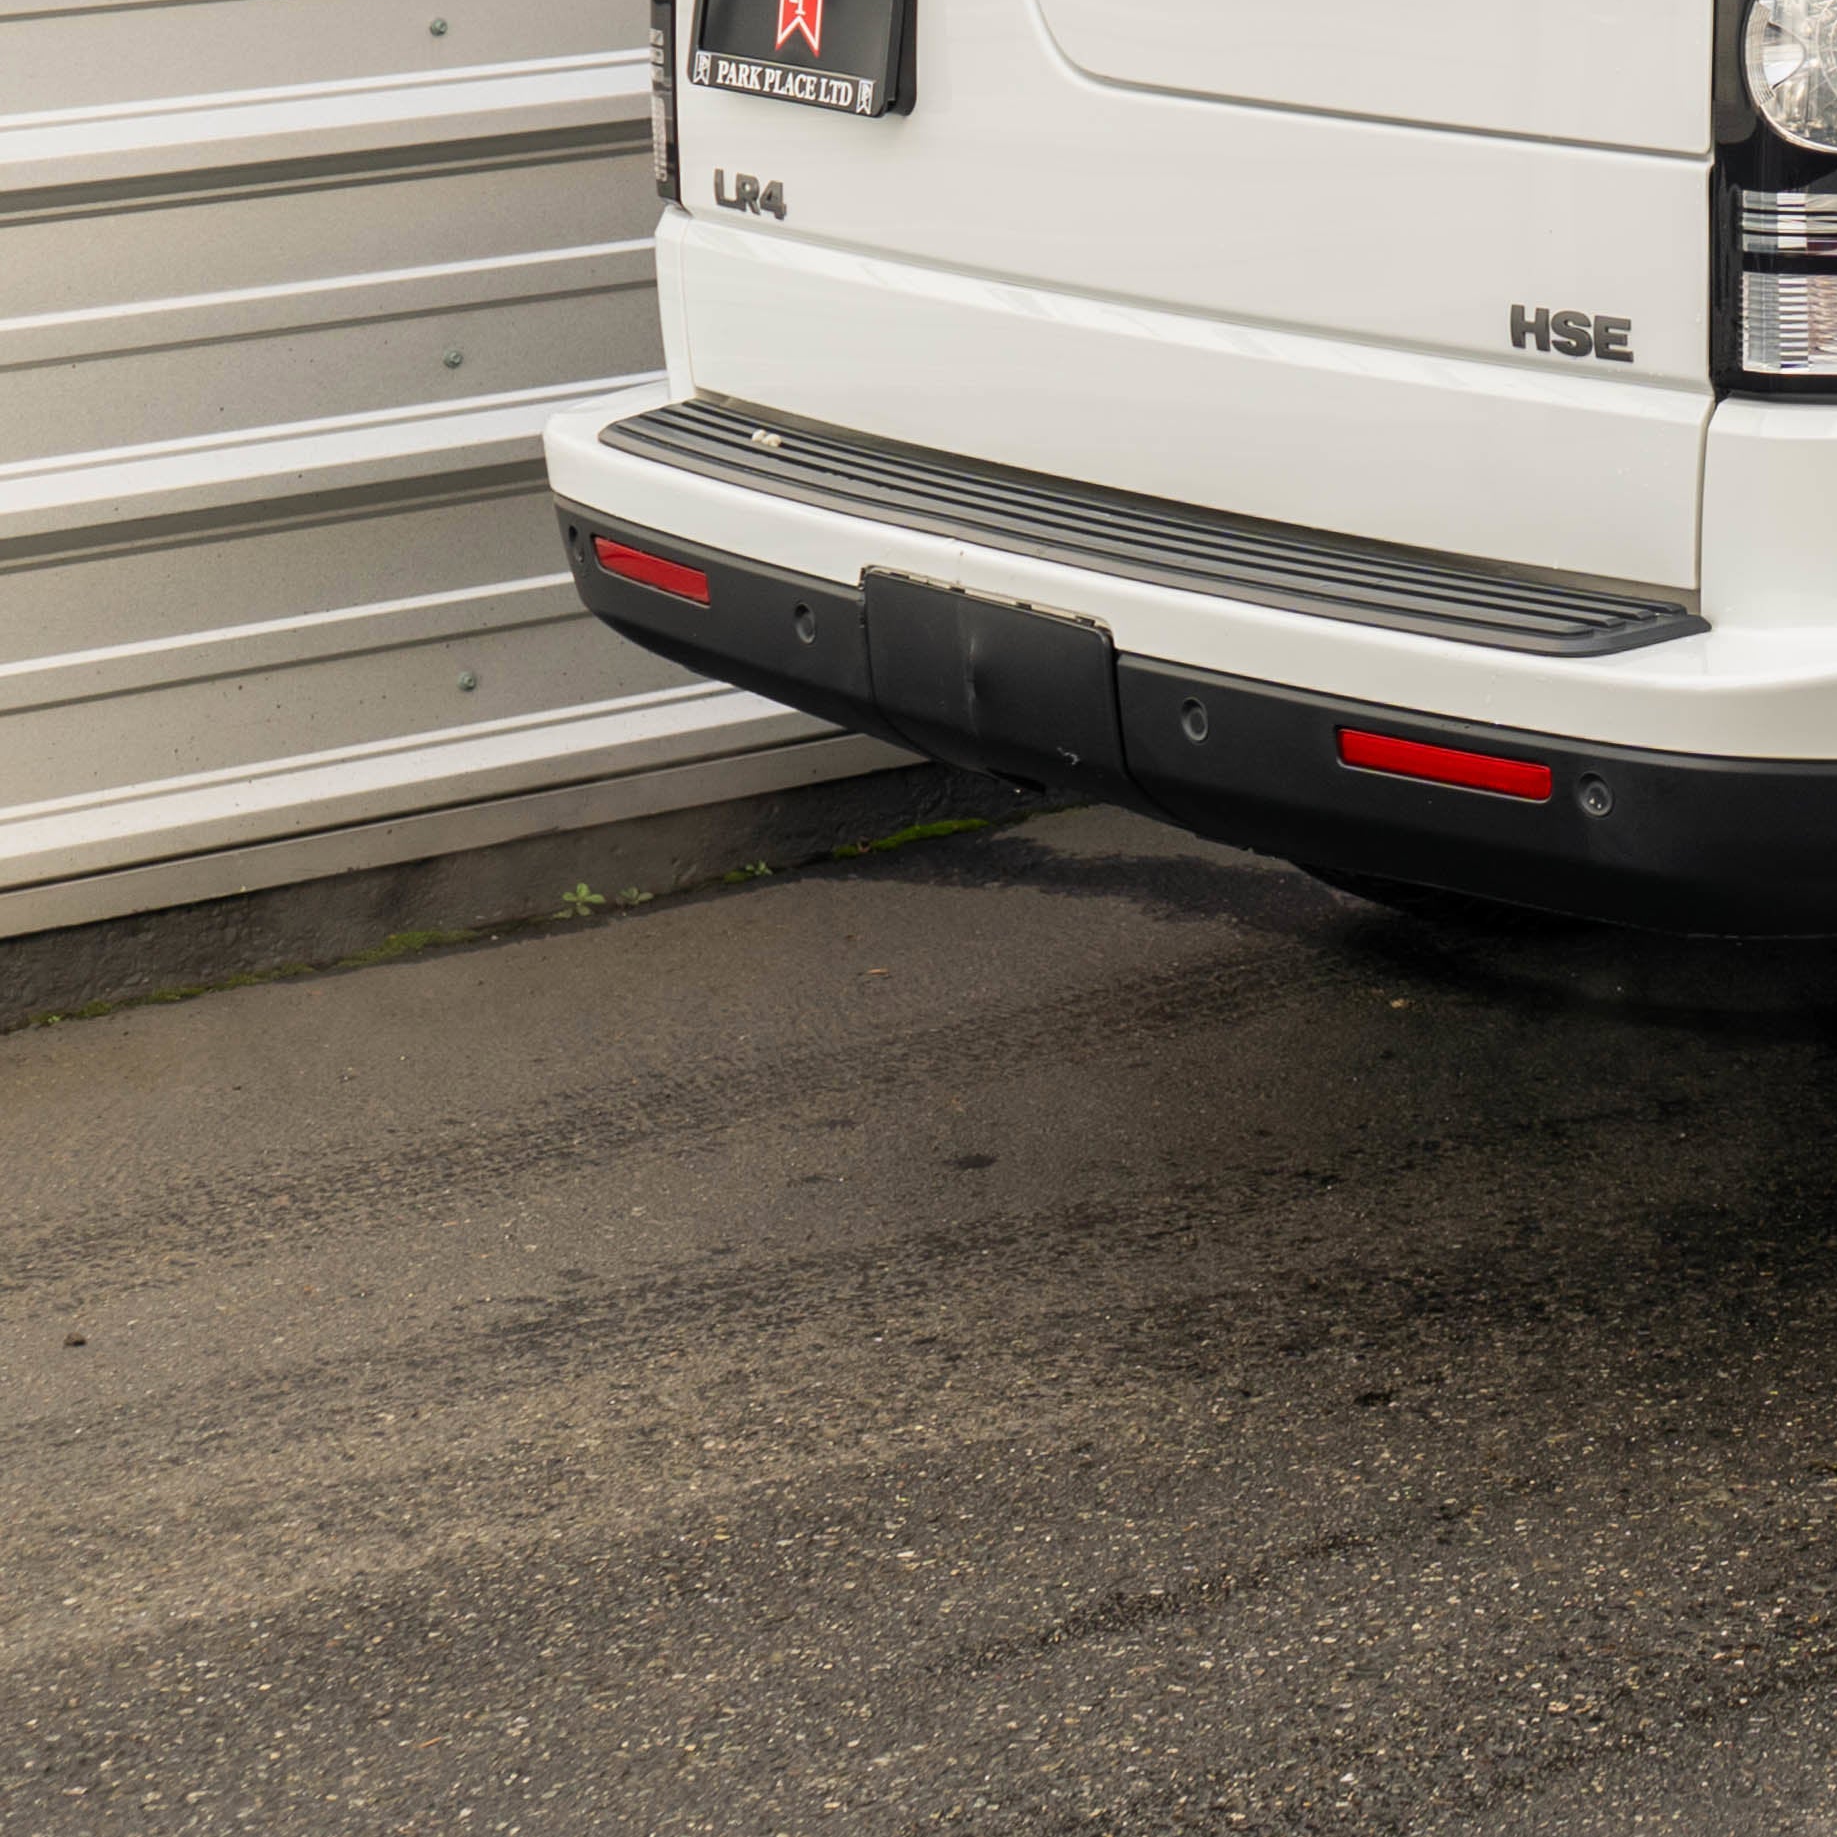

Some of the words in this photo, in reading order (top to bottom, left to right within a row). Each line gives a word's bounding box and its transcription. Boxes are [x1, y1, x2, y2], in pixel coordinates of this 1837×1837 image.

[716, 60, 763, 93] PARK
[763, 68, 818, 100] PLACE
[819, 77, 853, 107] LTD
[714, 168, 787, 221] LR4
[1510, 304, 1634, 363] HSE
